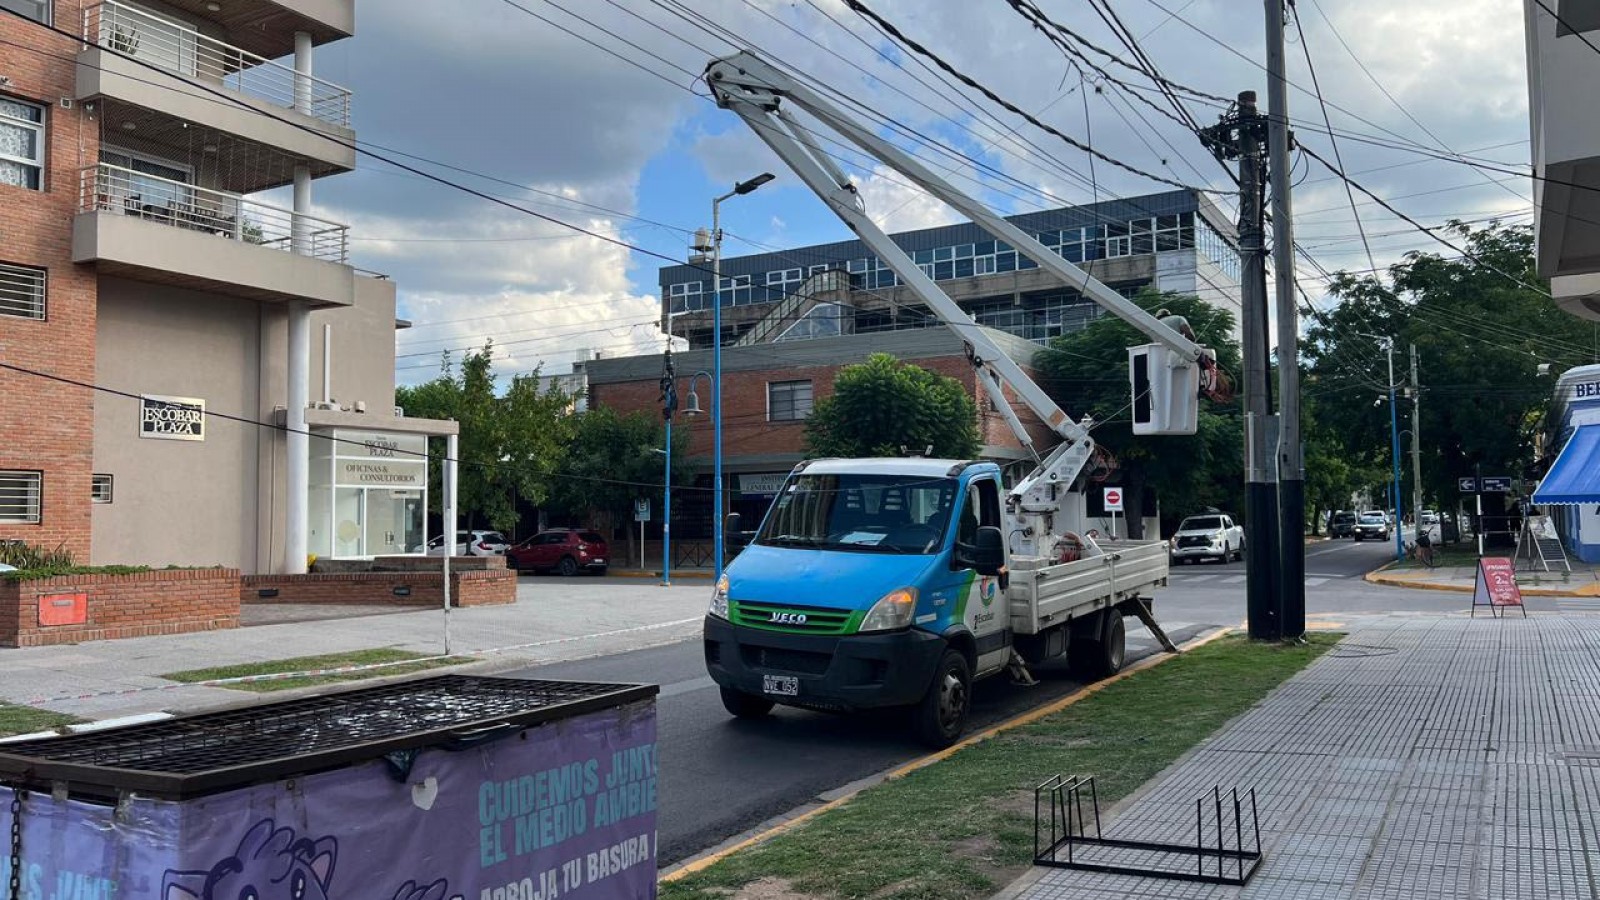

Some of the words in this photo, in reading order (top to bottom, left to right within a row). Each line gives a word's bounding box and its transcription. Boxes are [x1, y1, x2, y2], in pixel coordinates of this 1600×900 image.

[144, 407, 201, 422] ESCOBAR
[153, 420, 194, 435] PLAZA
[364, 440, 400, 450] ESCOBAR
[369, 448, 395, 457] PLAZA
[345, 464, 381, 473] OFICINAS
[360, 473, 416, 482] CONSULTORIOS
[478, 758, 599, 826] CUIDEMOS
[480, 824, 507, 868] EL
[515, 798, 587, 856] MEDIO
[562, 857, 581, 893] TU
[587, 833, 649, 883] BASURA
